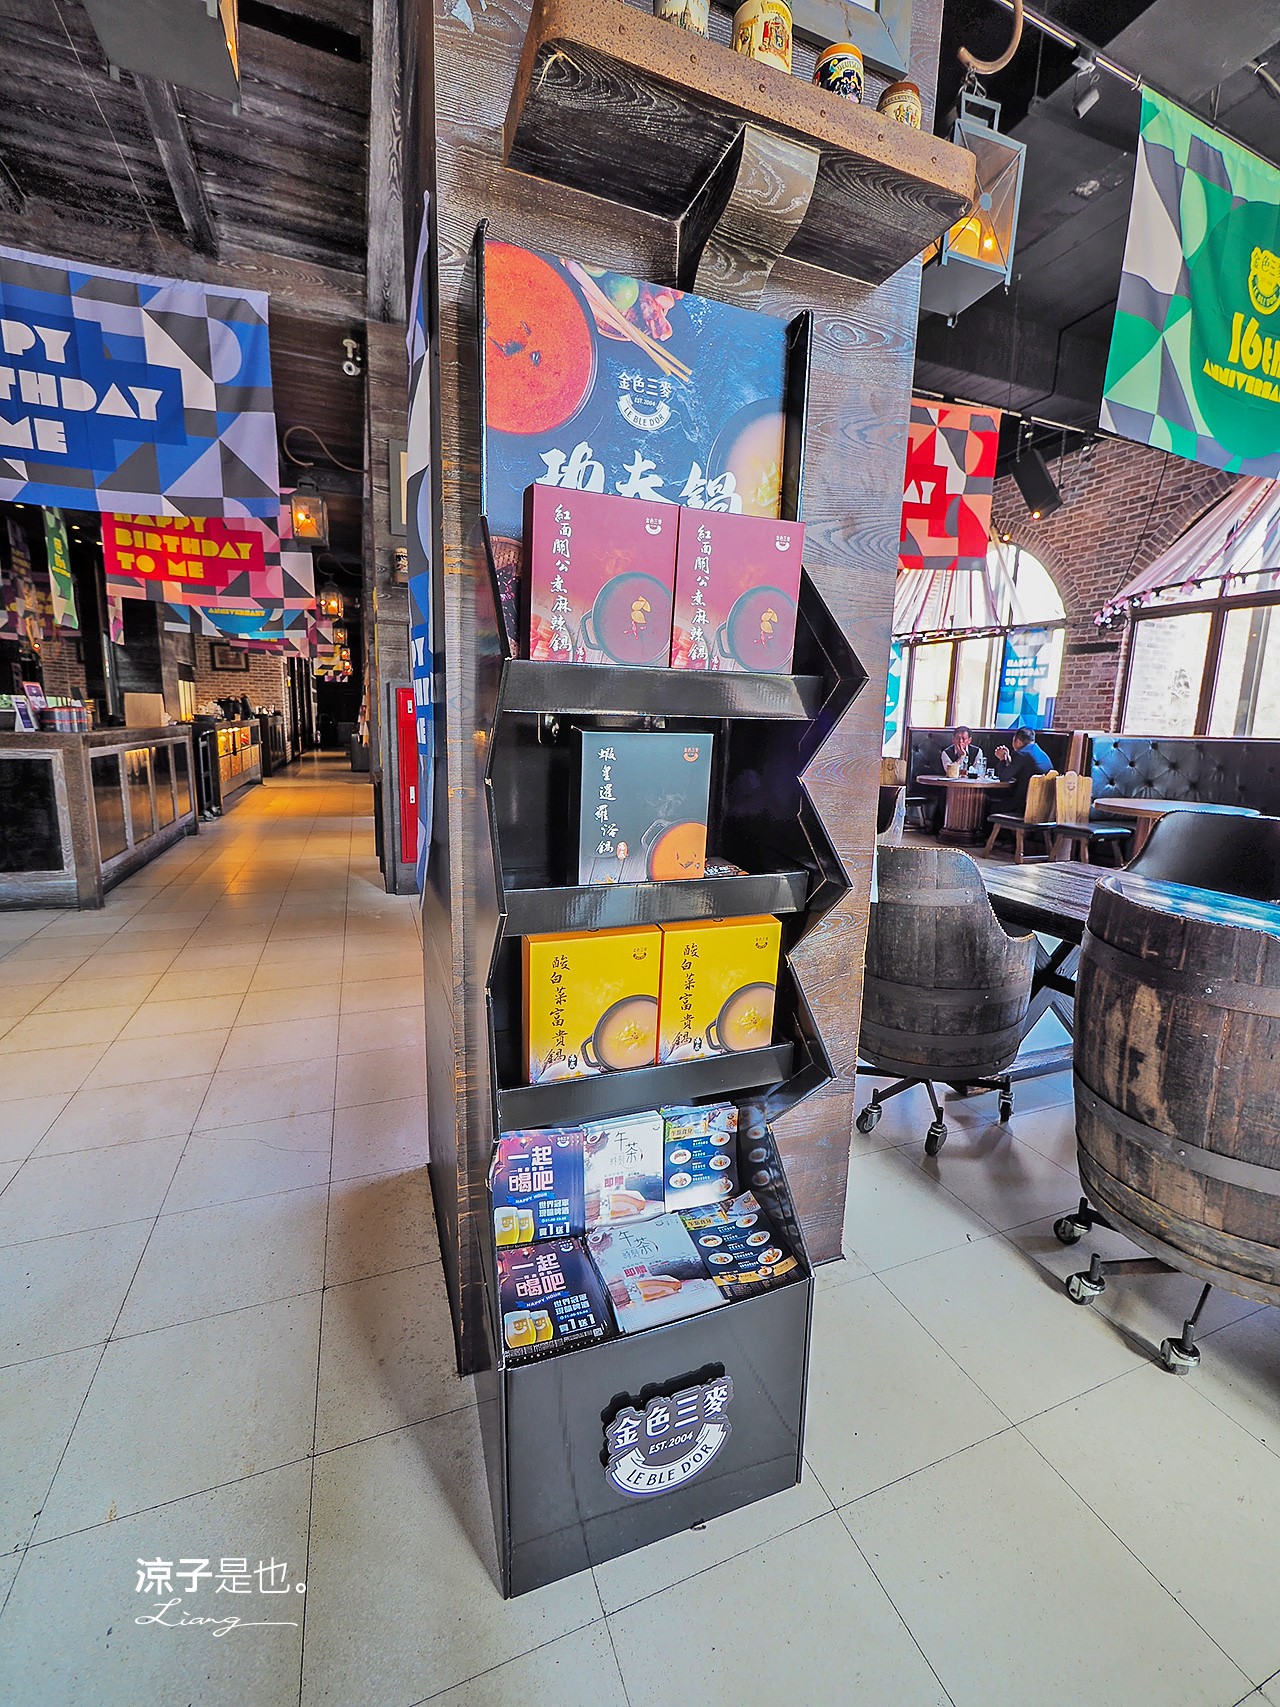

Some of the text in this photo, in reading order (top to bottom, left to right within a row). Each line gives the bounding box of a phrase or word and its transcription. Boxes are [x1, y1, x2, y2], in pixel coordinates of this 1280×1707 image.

[618, 371, 672, 399] 金色三麥
[623, 407, 632, 417] LE
[633, 415, 647, 426] BLE
[0, 416, 68, 454] ME
[115, 528, 253, 560] BIRTHDAY
[116, 551, 205, 579] TO ME
[672, 943, 700, 1046] 酸白菜富貴鍋
[544, 954, 570, 1065] 酸白菜富貴鍋
[508, 1145, 553, 1166] 一起
[509, 1170, 554, 1193] 喝吧
[511, 1252, 560, 1273] 一起
[515, 1272, 566, 1297] 喝吧
[526, 1292, 561, 1308] HAPPY HOUR
[613, 1385, 728, 1449] 金色三麥
[648, 1431, 694, 1455] EST.2004
[626, 1444, 713, 1486] LE BLE D'OR
